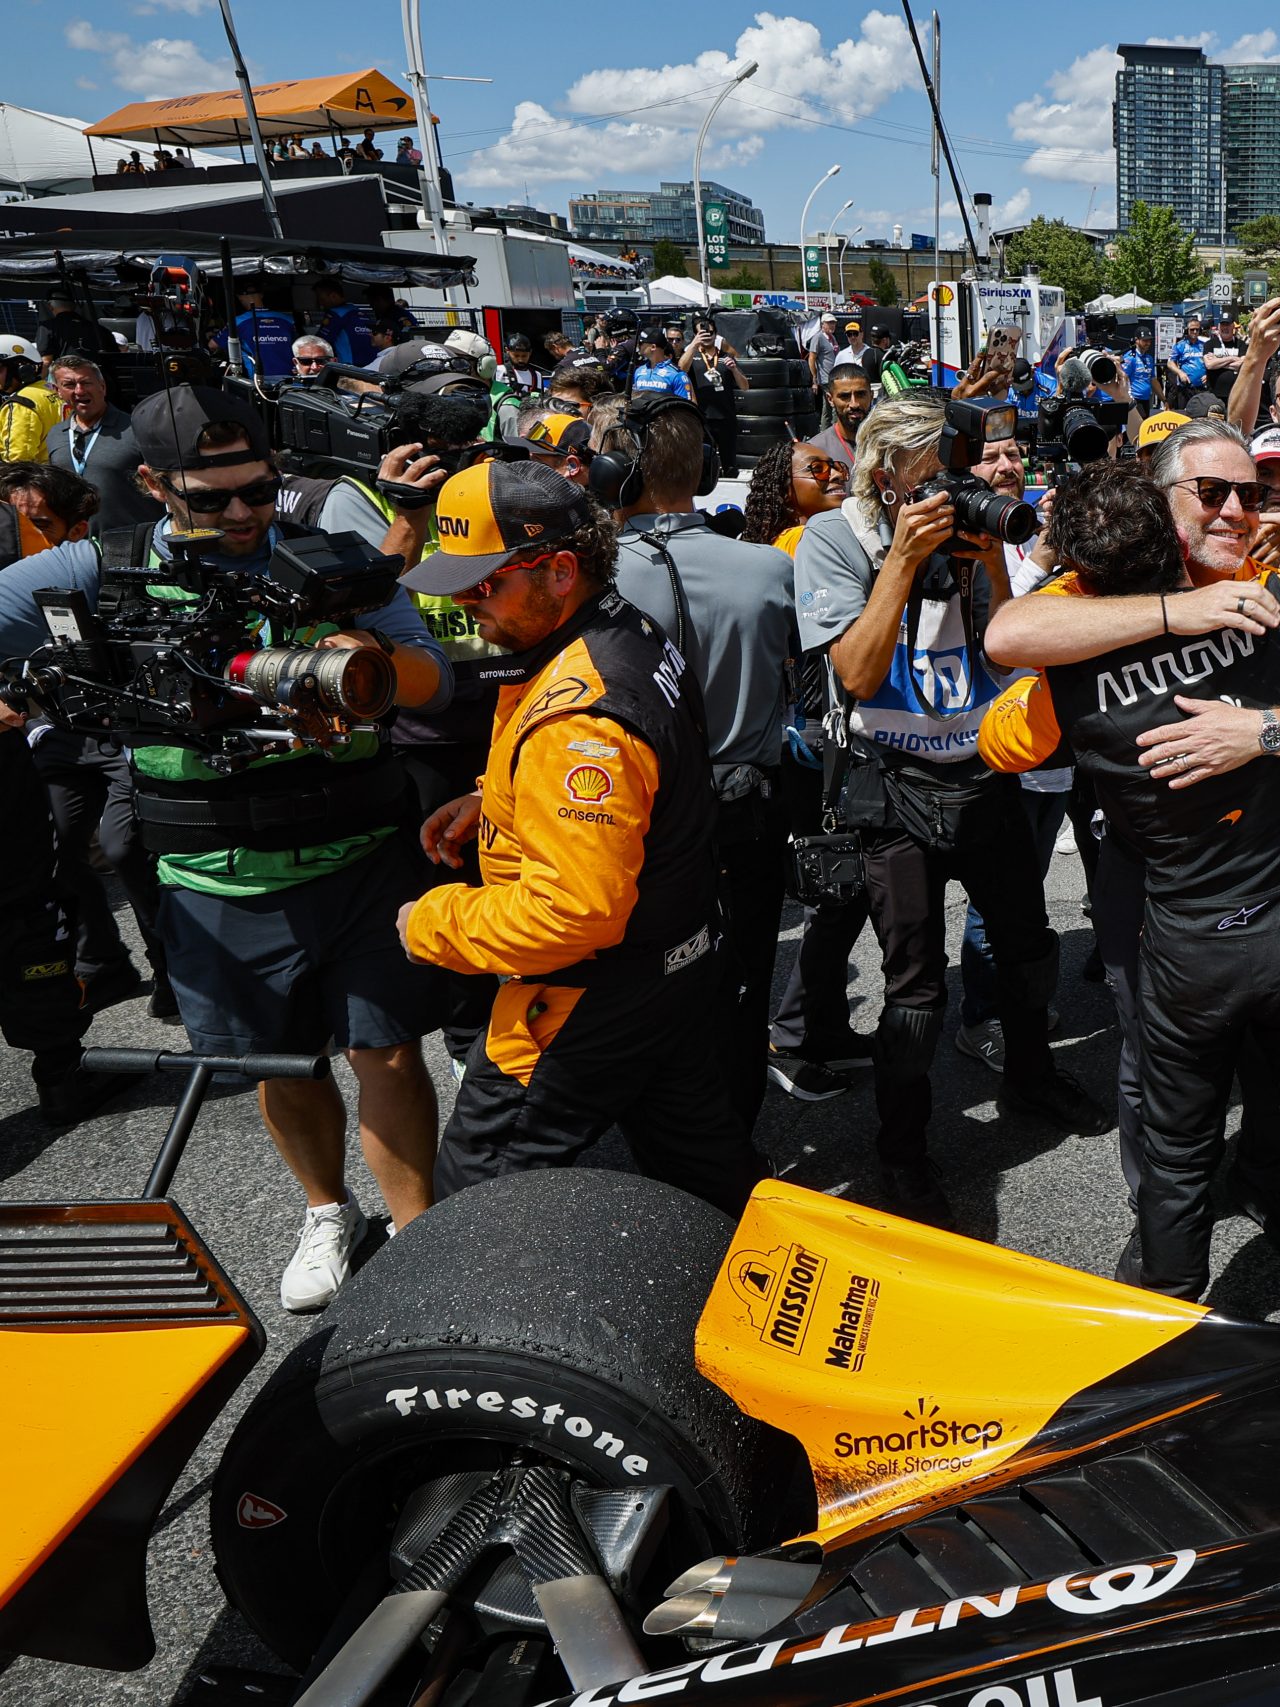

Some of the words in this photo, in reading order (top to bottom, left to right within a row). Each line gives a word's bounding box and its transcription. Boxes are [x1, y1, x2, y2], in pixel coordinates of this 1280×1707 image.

[706, 234, 725, 244] LOT
[708, 245, 726, 255] 853
[979, 286, 1032, 298] SiriusXM
[1214, 284, 1230, 296] 20
[252, 334, 288, 342] Carience
[169, 362, 179, 371] 5
[346, 428, 370, 440] Panasonic
[1146, 422, 1183, 435] ARRO
[960, 565, 969, 598] EOS
[479, 667, 526, 679] arrow.com
[1097, 628, 1255, 713] ARROW
[824, 1274, 870, 1370] Mahatma
[386, 1385, 649, 1478] Firestone
[833, 1417, 1003, 1460] SmartStop
[866, 1457, 900, 1476] Self
[904, 1456, 973, 1473] Storage
